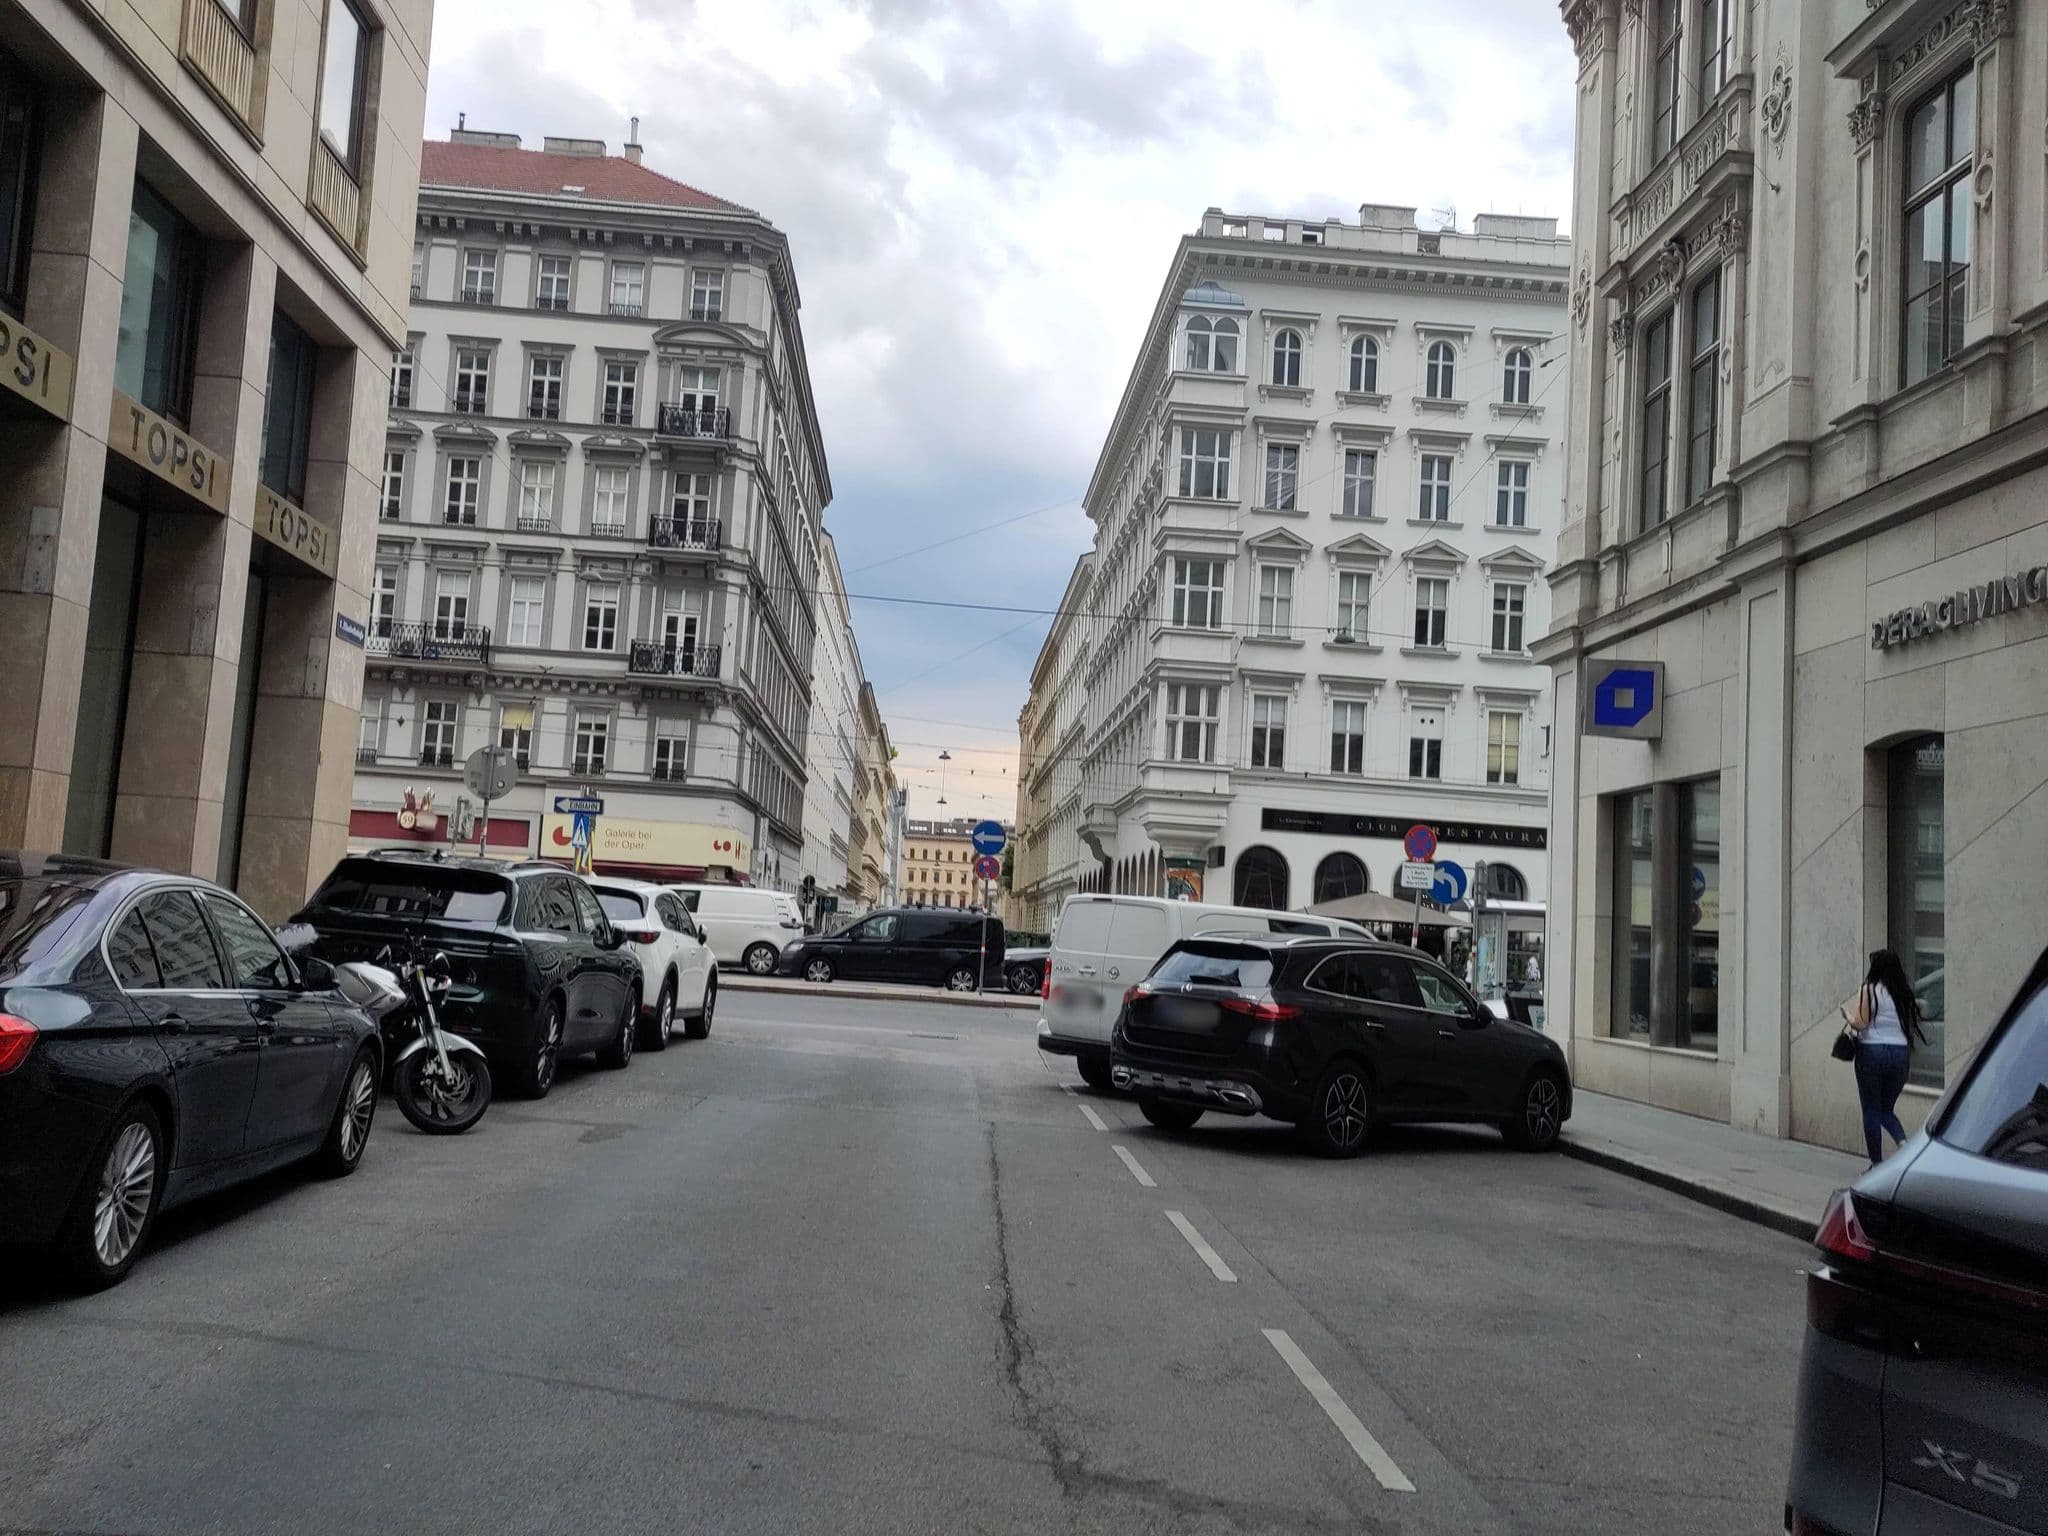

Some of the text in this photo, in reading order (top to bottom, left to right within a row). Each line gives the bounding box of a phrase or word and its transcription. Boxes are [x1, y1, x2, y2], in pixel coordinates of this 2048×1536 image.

[129, 405, 216, 498] TOPSI
[267, 495, 328, 567] TOPSI
[569, 801, 599, 810] EINBAHN
[1356, 821, 1398, 833] CLUB
[605, 828, 652, 839] Galerie bei
[604, 839, 619, 849] der
[1911, 1439, 2021, 1500] X5
